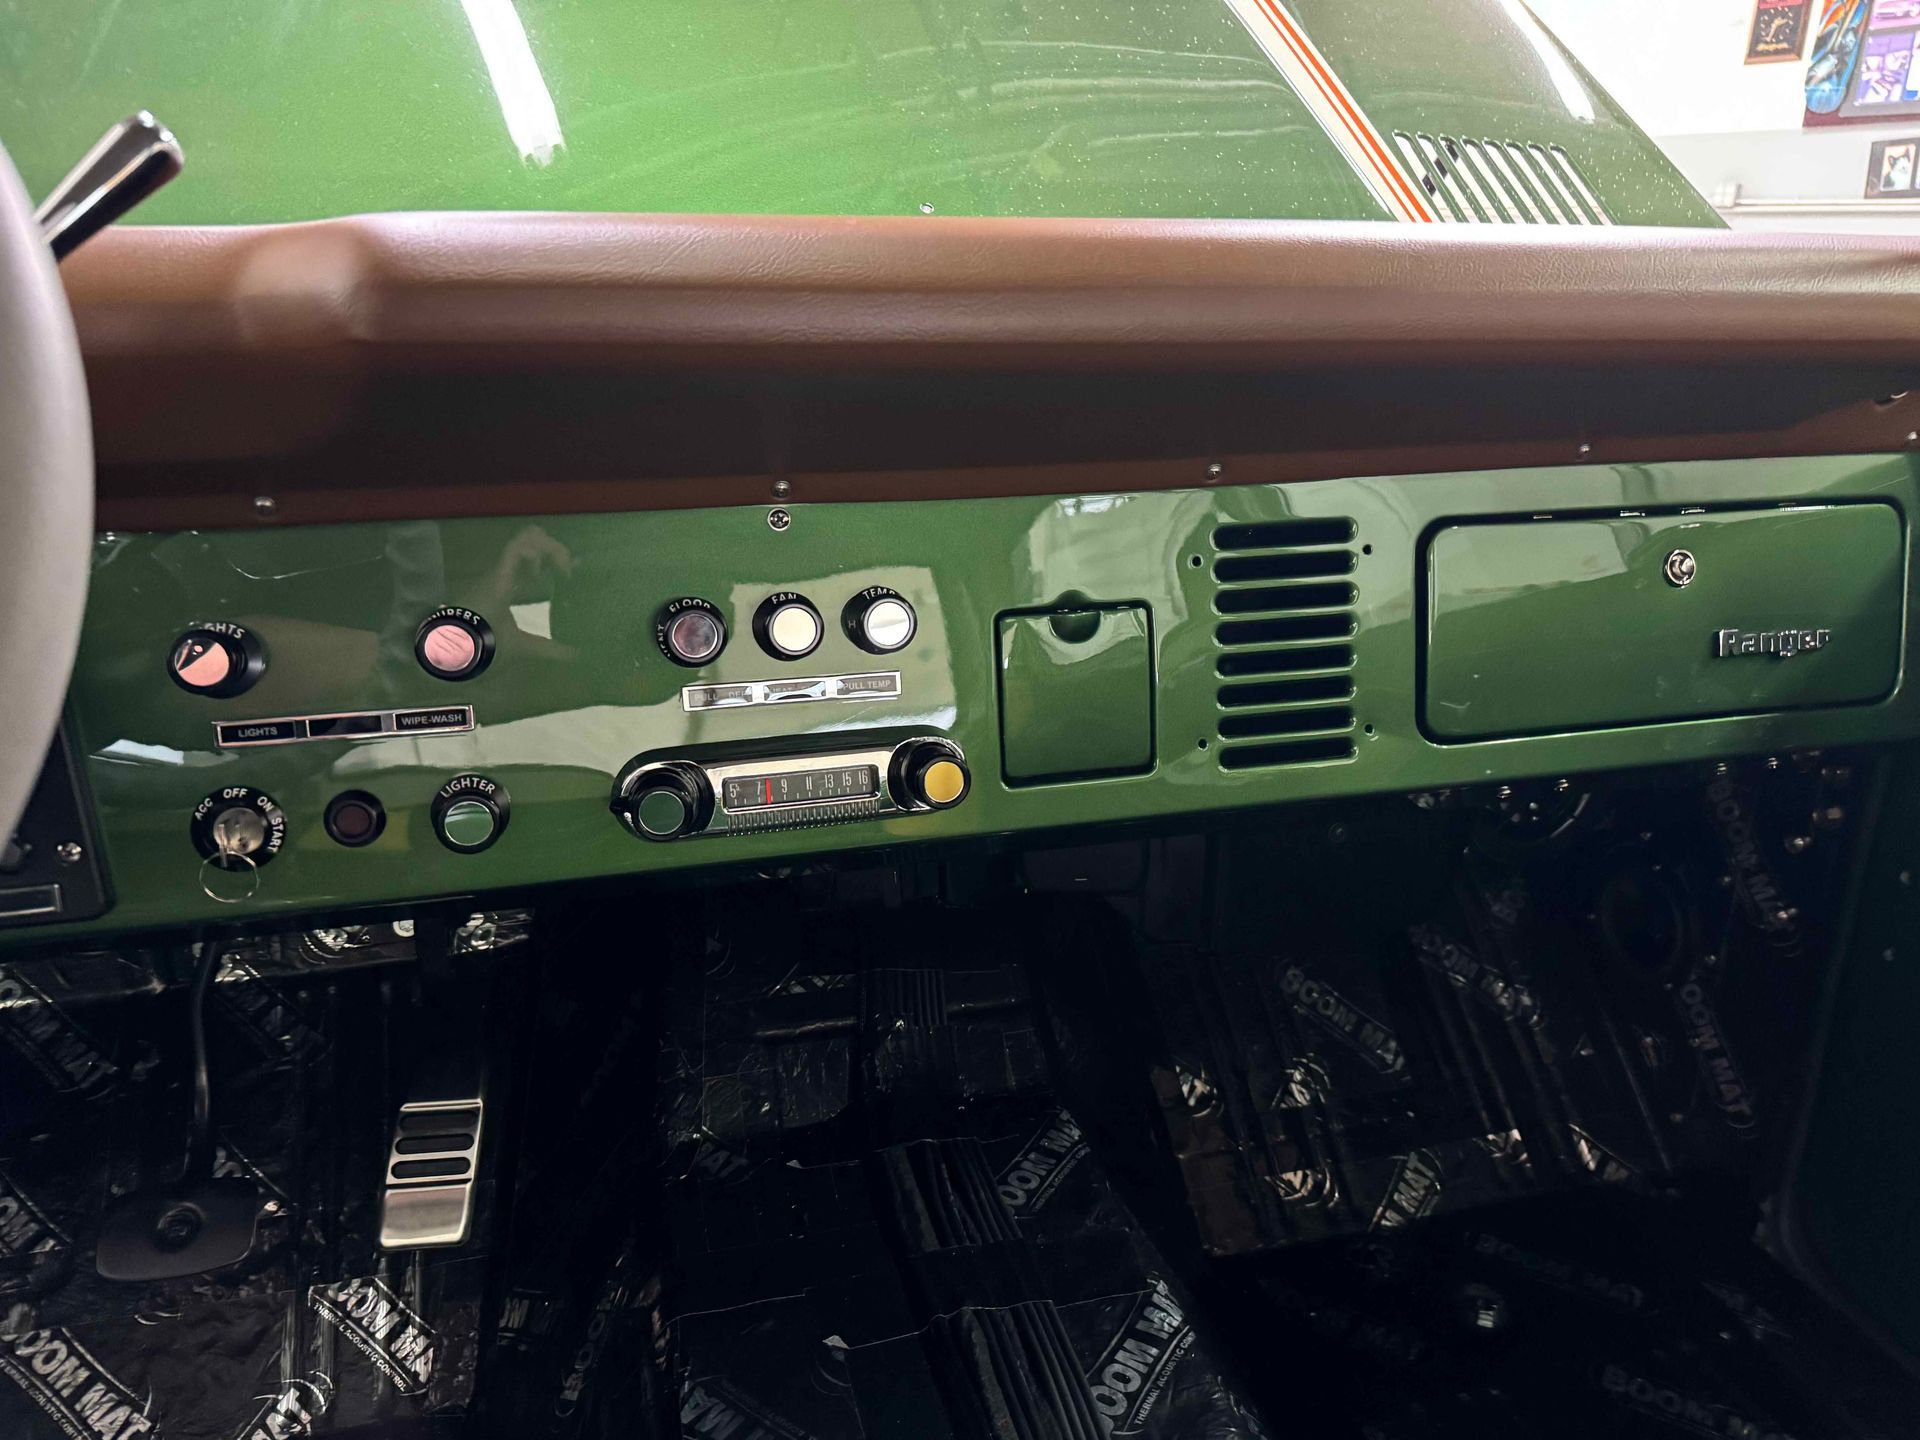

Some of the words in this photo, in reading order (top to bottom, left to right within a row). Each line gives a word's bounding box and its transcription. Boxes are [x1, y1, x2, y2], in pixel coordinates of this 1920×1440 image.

[203, 621, 246, 640] GHTS
[1718, 629, 1832, 658] Ranger
[843, 681, 865, 691] PULL
[867, 679, 891, 689] TEMP
[237, 725, 278, 738] LIGHTS
[401, 712, 463, 726] WIPE-WASH
[440, 776, 496, 799] LIGHTER
[780, 778, 788, 793] 9
[806, 775, 813, 790] 11
[824, 773, 835, 789] 13
[842, 771, 853, 786] 15
[858, 769, 869, 784] 16
[194, 797, 214, 821] ACC
[223, 787, 248, 799] OFF
[257, 796, 275, 812] ON
[267, 817, 284, 853] START
[1393, 1151, 1436, 1215] MAT
[313, 1302, 346, 1332] THERL
[375, 1358, 408, 1392] CONTROL
[388, 1324, 435, 1384] MA
[1133, 1386, 1161, 1425] THERMAL
[1157, 1346, 1185, 1389] ACOUSTIC
[1179, 1330, 1197, 1351] CONT
[73, 1381, 153, 1440] MAT
